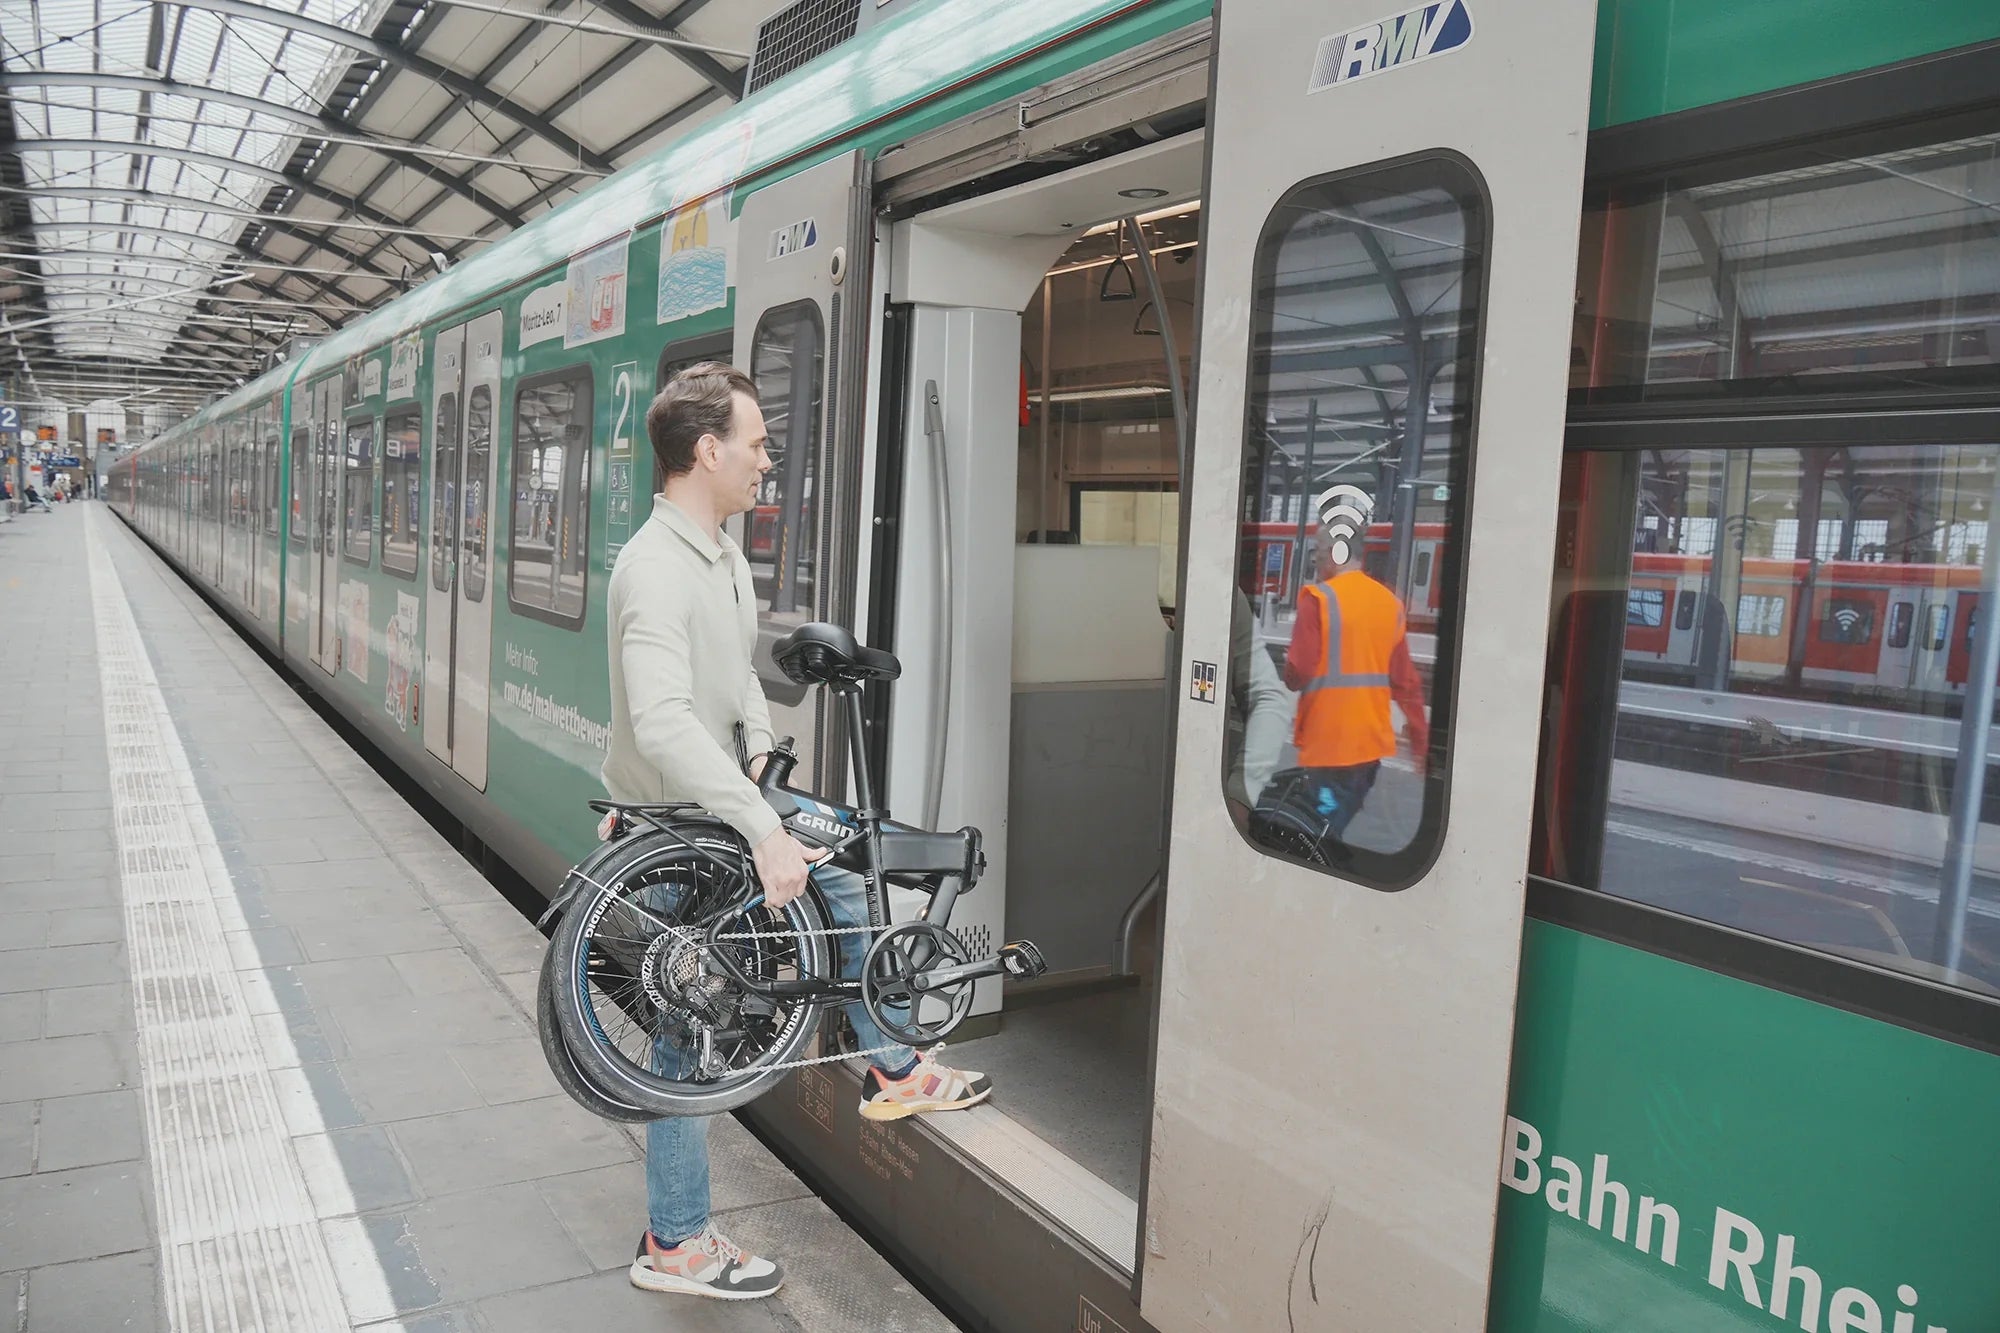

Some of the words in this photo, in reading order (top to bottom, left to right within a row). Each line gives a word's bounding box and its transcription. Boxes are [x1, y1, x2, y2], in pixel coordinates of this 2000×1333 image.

[1337, 0, 1457, 82] RMV
[776, 219, 813, 258] RMV
[0, 407, 17, 428] 2
[612, 370, 631, 449] 2
[505, 641, 521, 669] Mehr
[522, 647, 538, 676] Info:
[796, 811, 858, 839] GRUN
[1500, 1115, 1681, 1267] Bahn
[1708, 1206, 1948, 1333] Rhei
